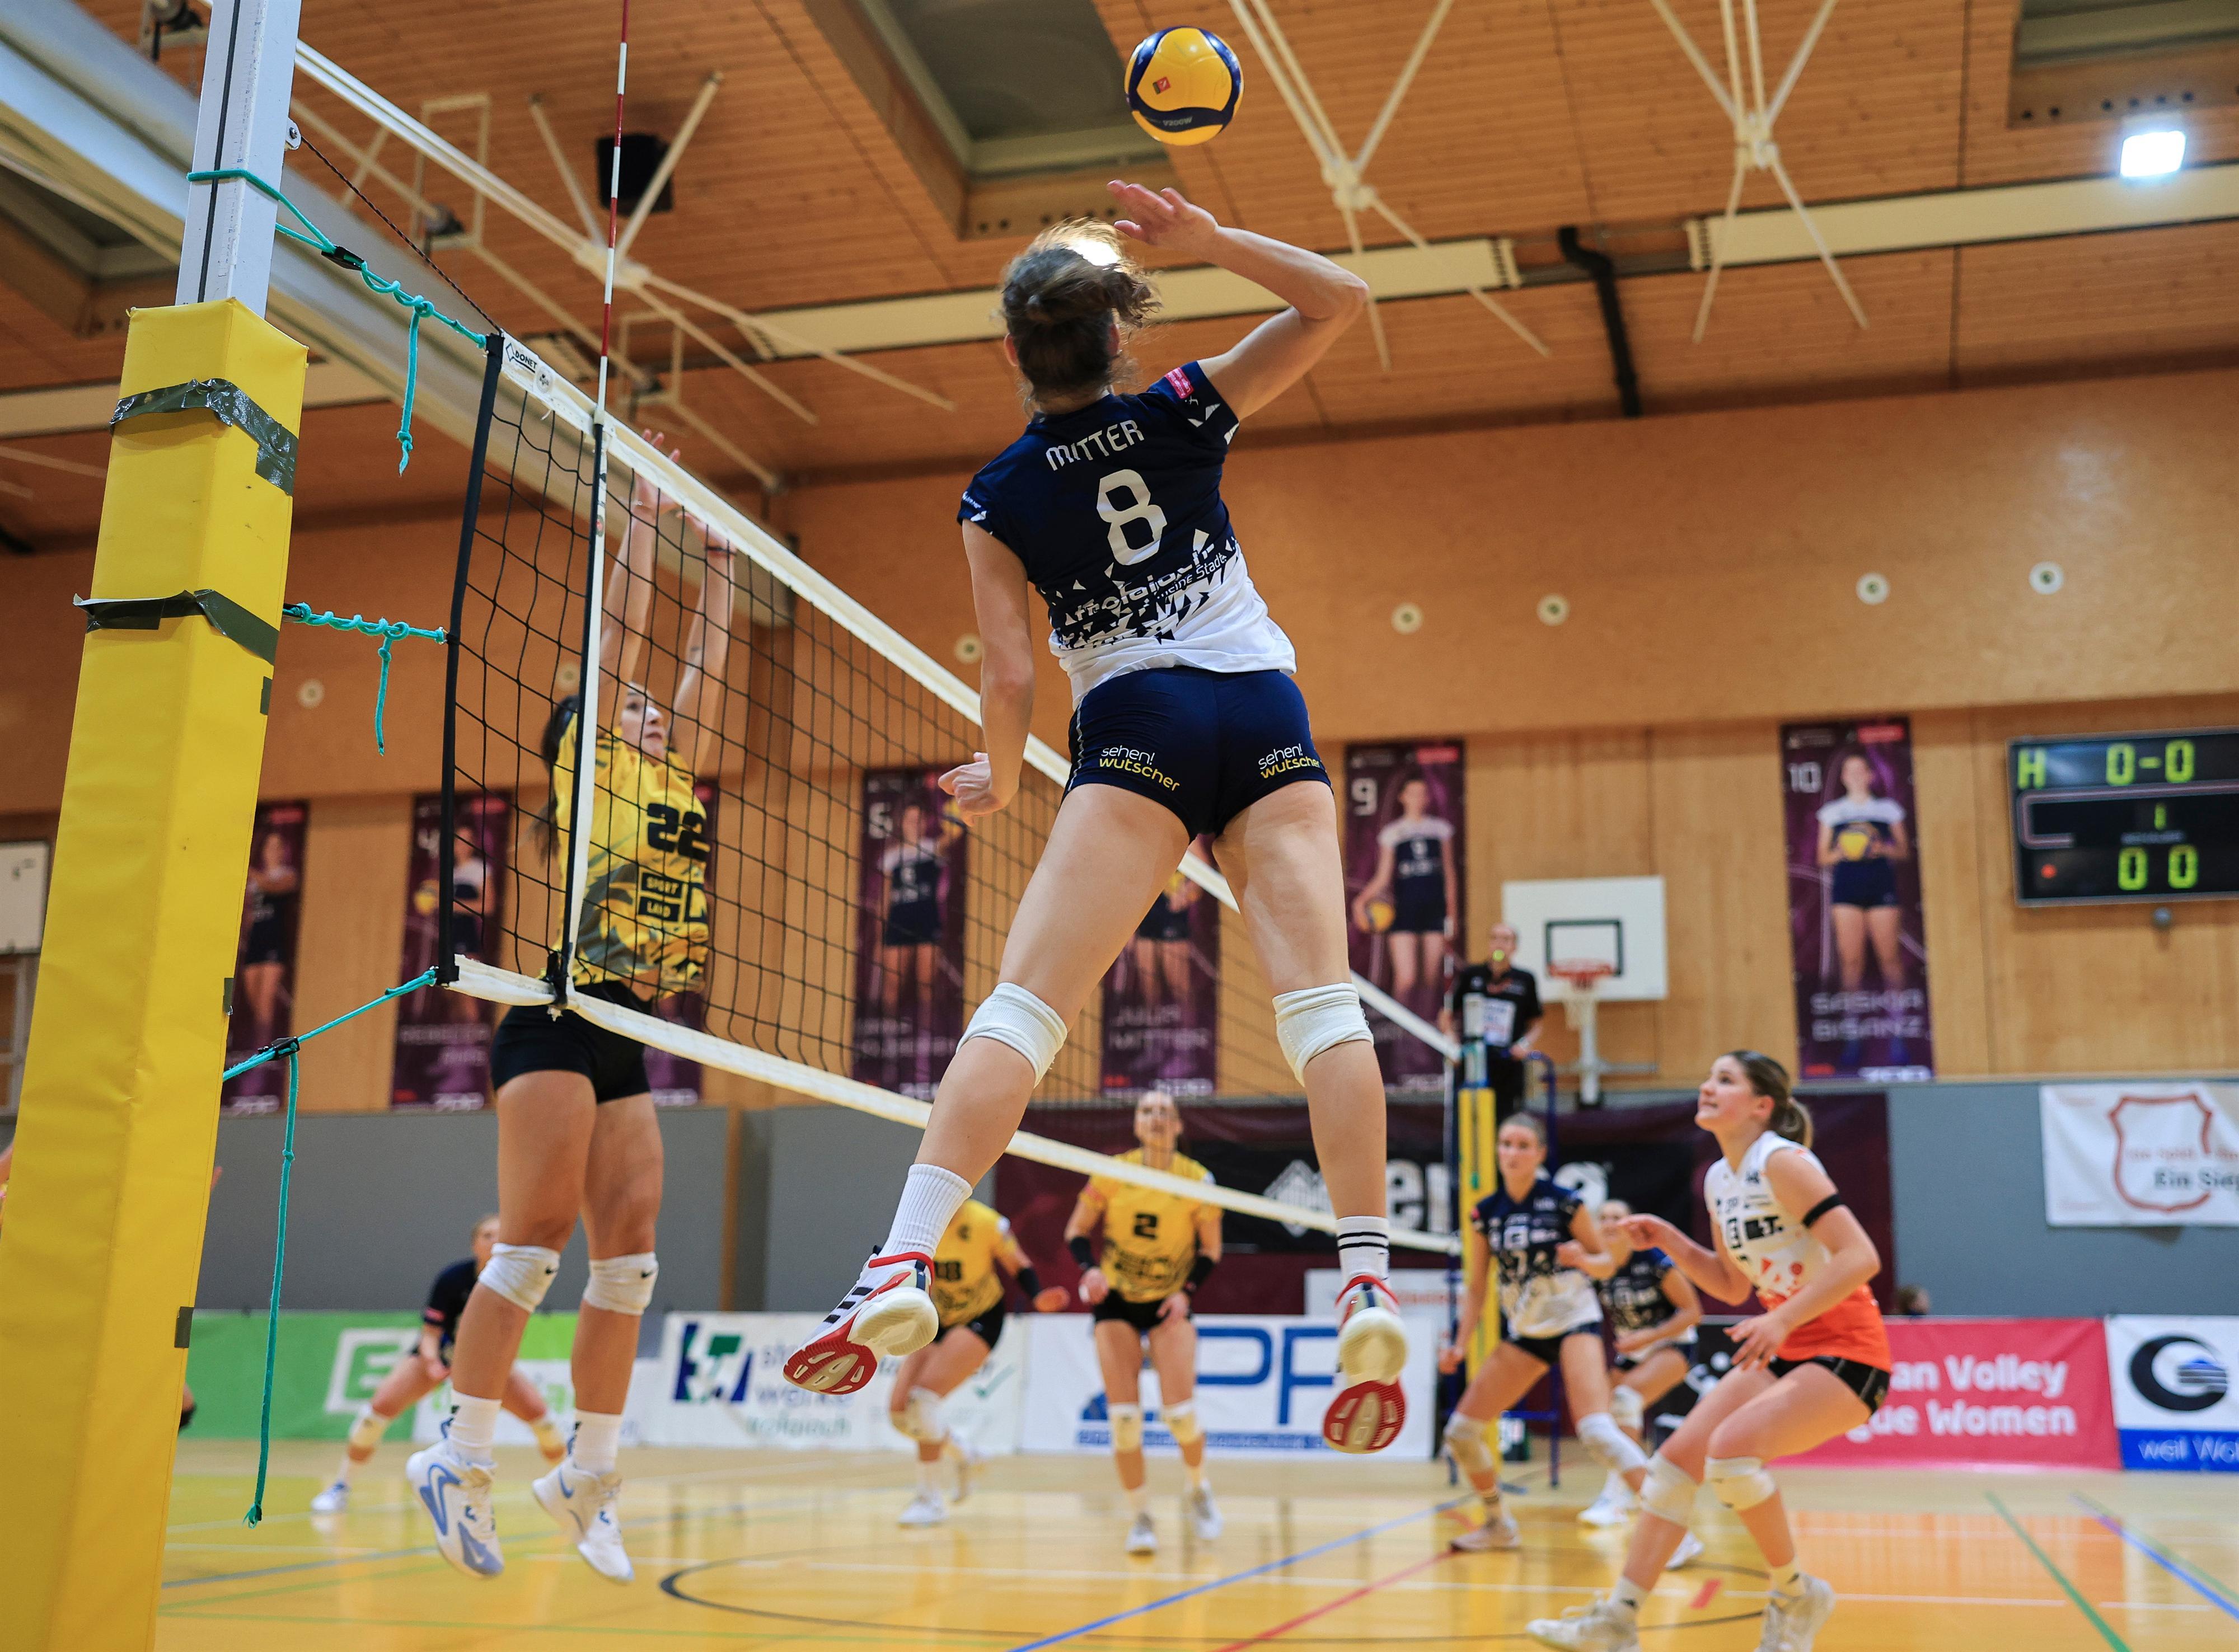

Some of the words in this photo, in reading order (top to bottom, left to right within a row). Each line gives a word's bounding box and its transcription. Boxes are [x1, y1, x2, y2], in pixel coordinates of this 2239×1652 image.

[1163, 116, 1193, 126] V200W
[1046, 420, 1145, 471] MITTER
[1096, 469, 1168, 566] 8
[1101, 745, 1155, 765] sehen!
[1258, 743, 1303, 770] sehen!
[1260, 755, 1320, 779] wutscher
[2017, 748, 2046, 790] H
[1099, 758, 1180, 791] wutscher
[1790, 762, 1823, 794] 10
[1351, 777, 1378, 816] 9
[647, 802, 709, 862] 22
[868, 802, 893, 839] 5
[2154, 802, 2167, 831] 1
[1132, 1212, 1159, 1240] 2
[1943, 1353, 2069, 1399] Volley
[1926, 1398, 2078, 1437] Women
